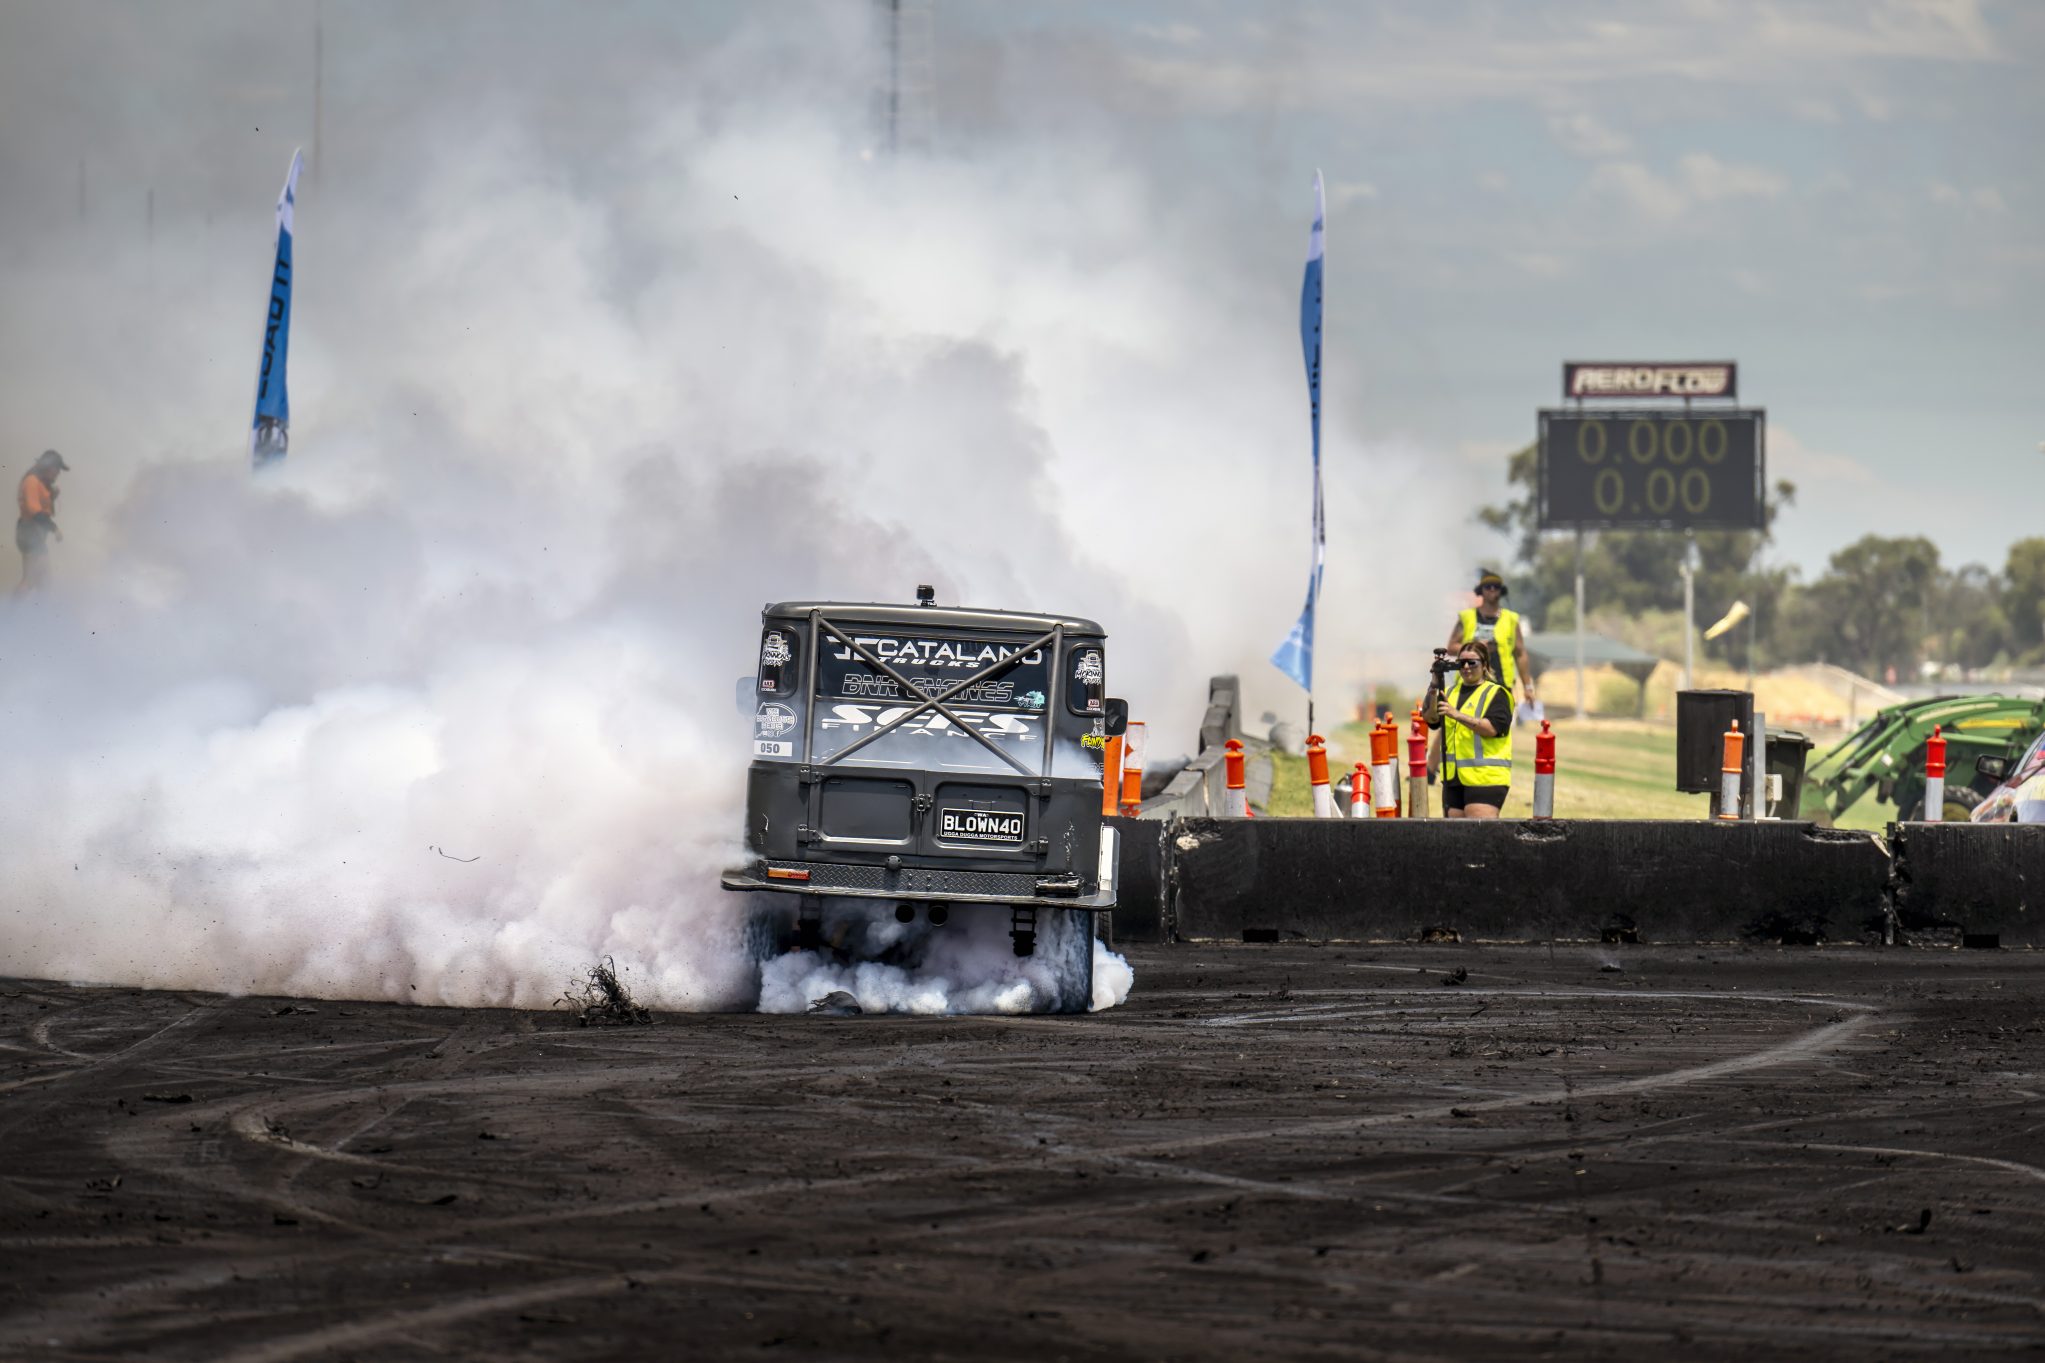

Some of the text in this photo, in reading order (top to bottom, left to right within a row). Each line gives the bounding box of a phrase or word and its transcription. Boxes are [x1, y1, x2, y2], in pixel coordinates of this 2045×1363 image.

[1572, 367, 1729, 394] AEROFLOW
[1578, 417, 1728, 465] 0.000
[1594, 467, 1711, 515] 0.00
[877, 638, 1043, 665] CATALANO
[878, 656, 981, 668] TRUCKS
[760, 743, 780, 754] 050
[943, 814, 1021, 835] BLOWN40
